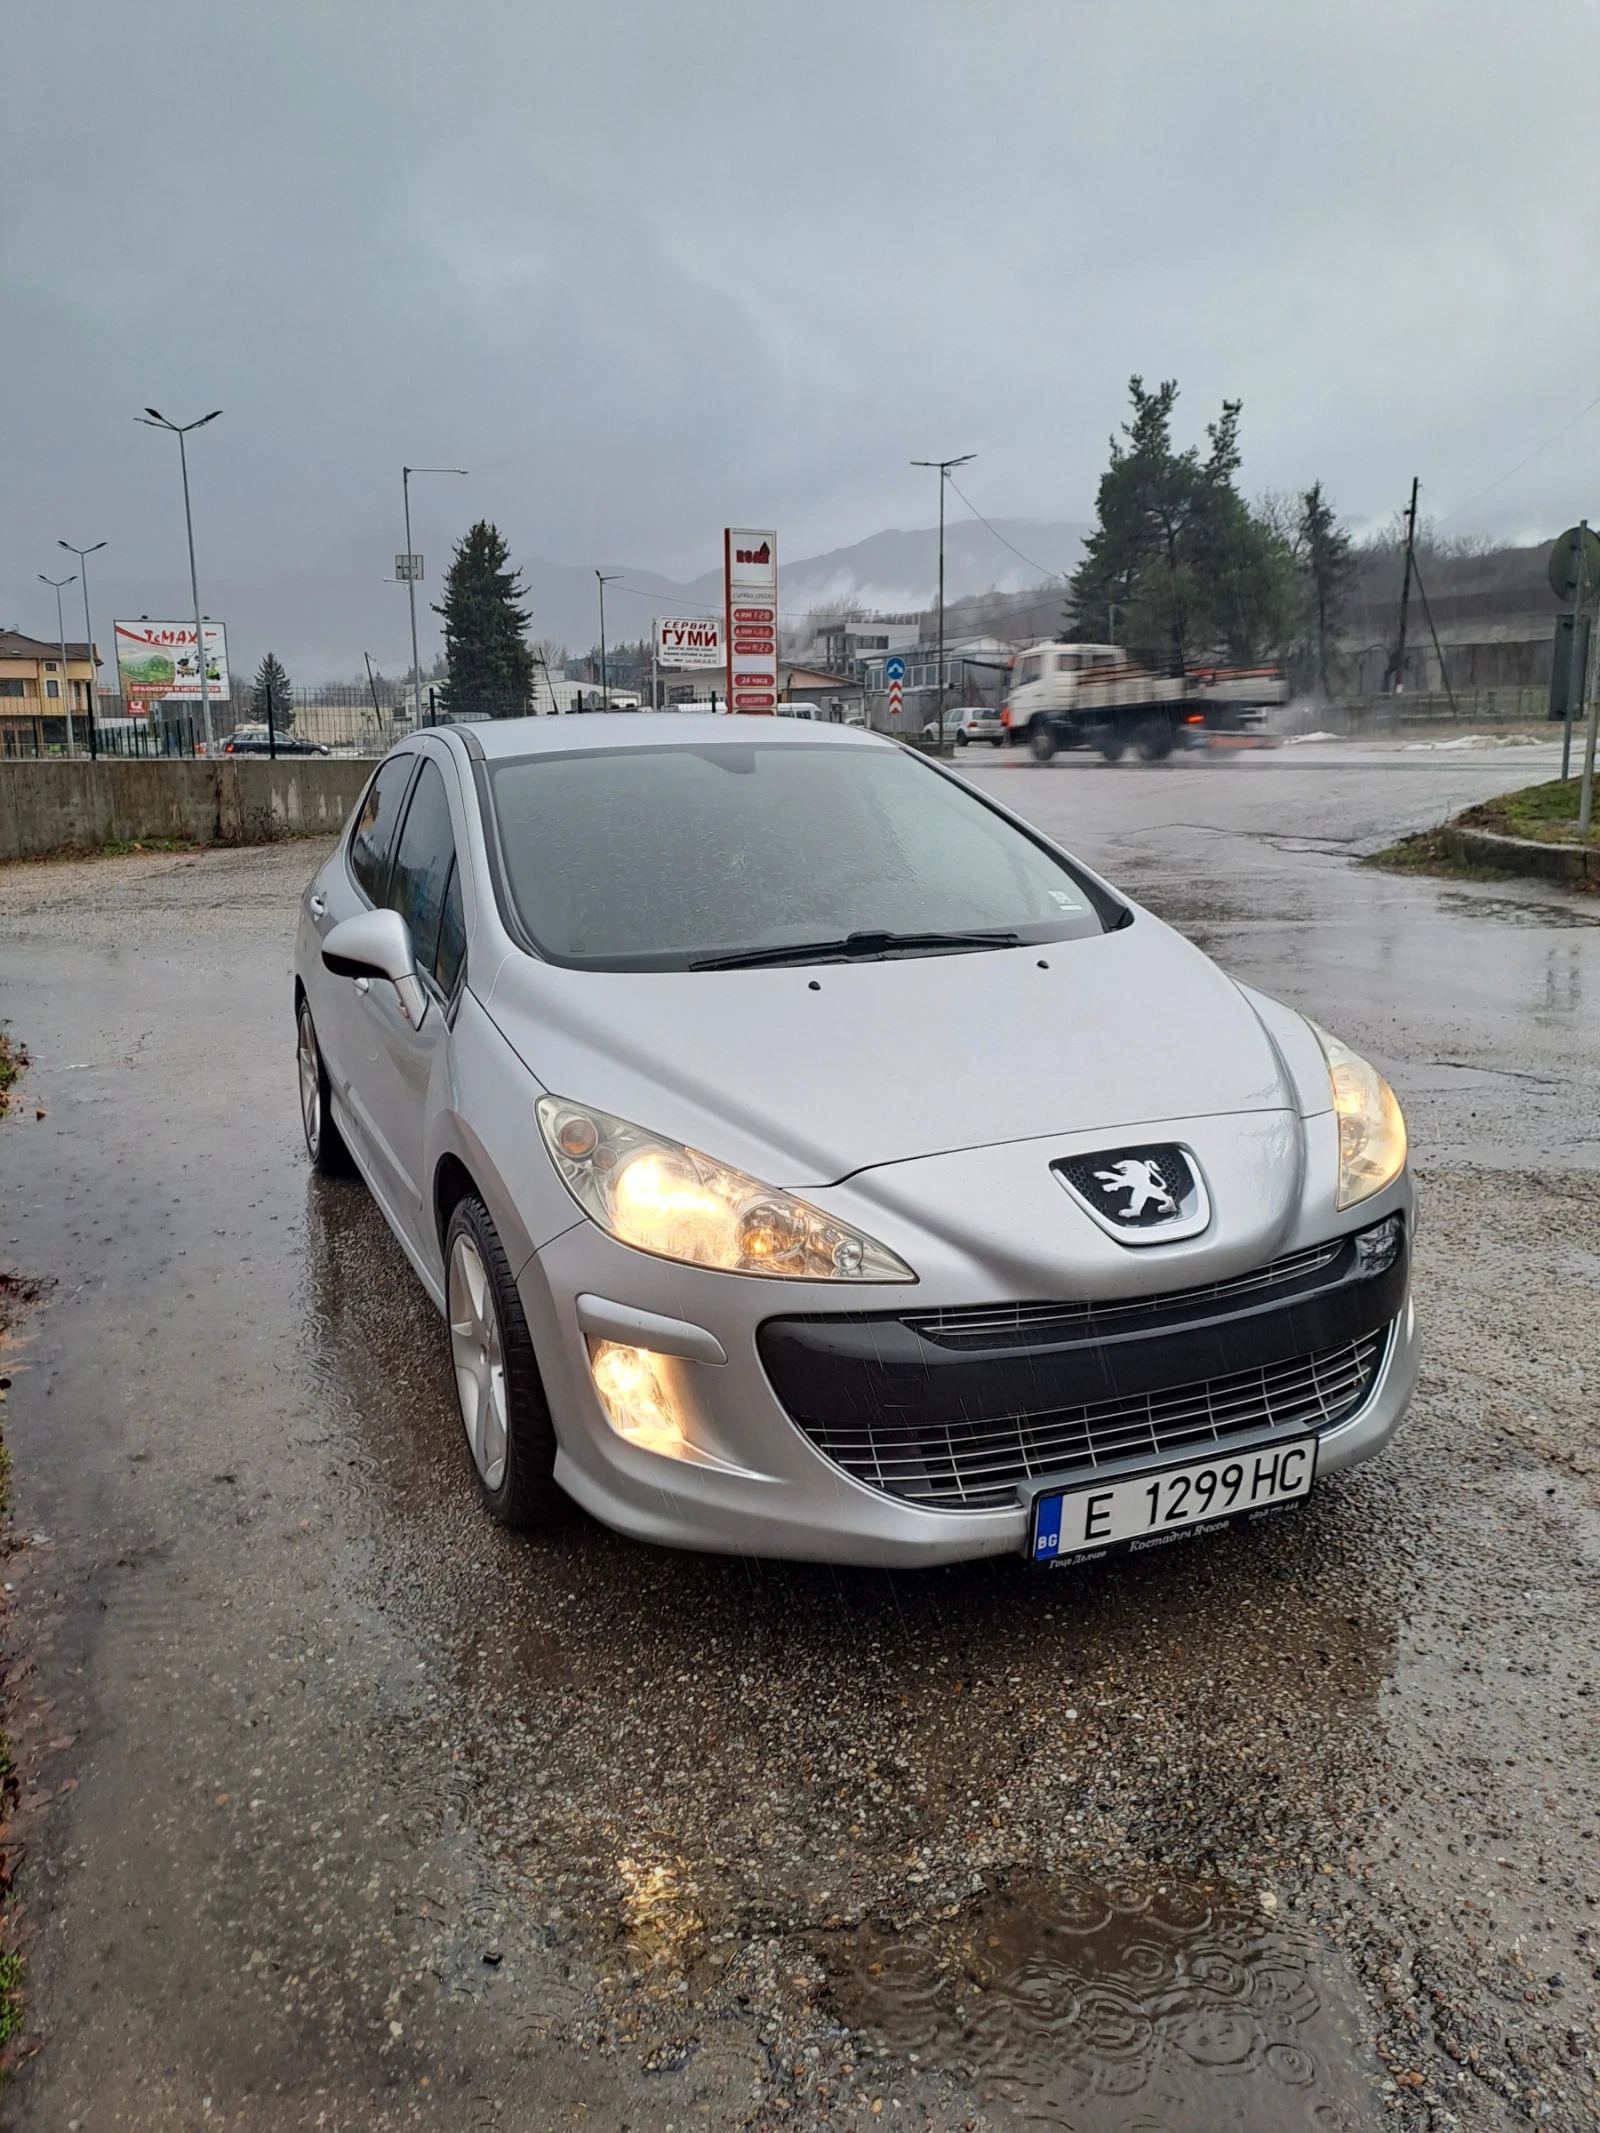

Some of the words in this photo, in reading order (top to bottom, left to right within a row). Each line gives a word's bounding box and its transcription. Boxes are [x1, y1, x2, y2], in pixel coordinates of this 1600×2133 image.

[664, 621, 715, 631] СЕРВИЗ
[662, 629, 717, 647] ГУМИ
[741, 676, 750, 684] 24
[1084, 1492, 1114, 1541] E
[1146, 1463, 1243, 1527] 1299
[1250, 1448, 1306, 1501] HC
[1037, 1533, 1058, 1550] BG
[1048, 1558, 1072, 1570] Гоце
[1128, 1529, 1192, 1552] Костадин
